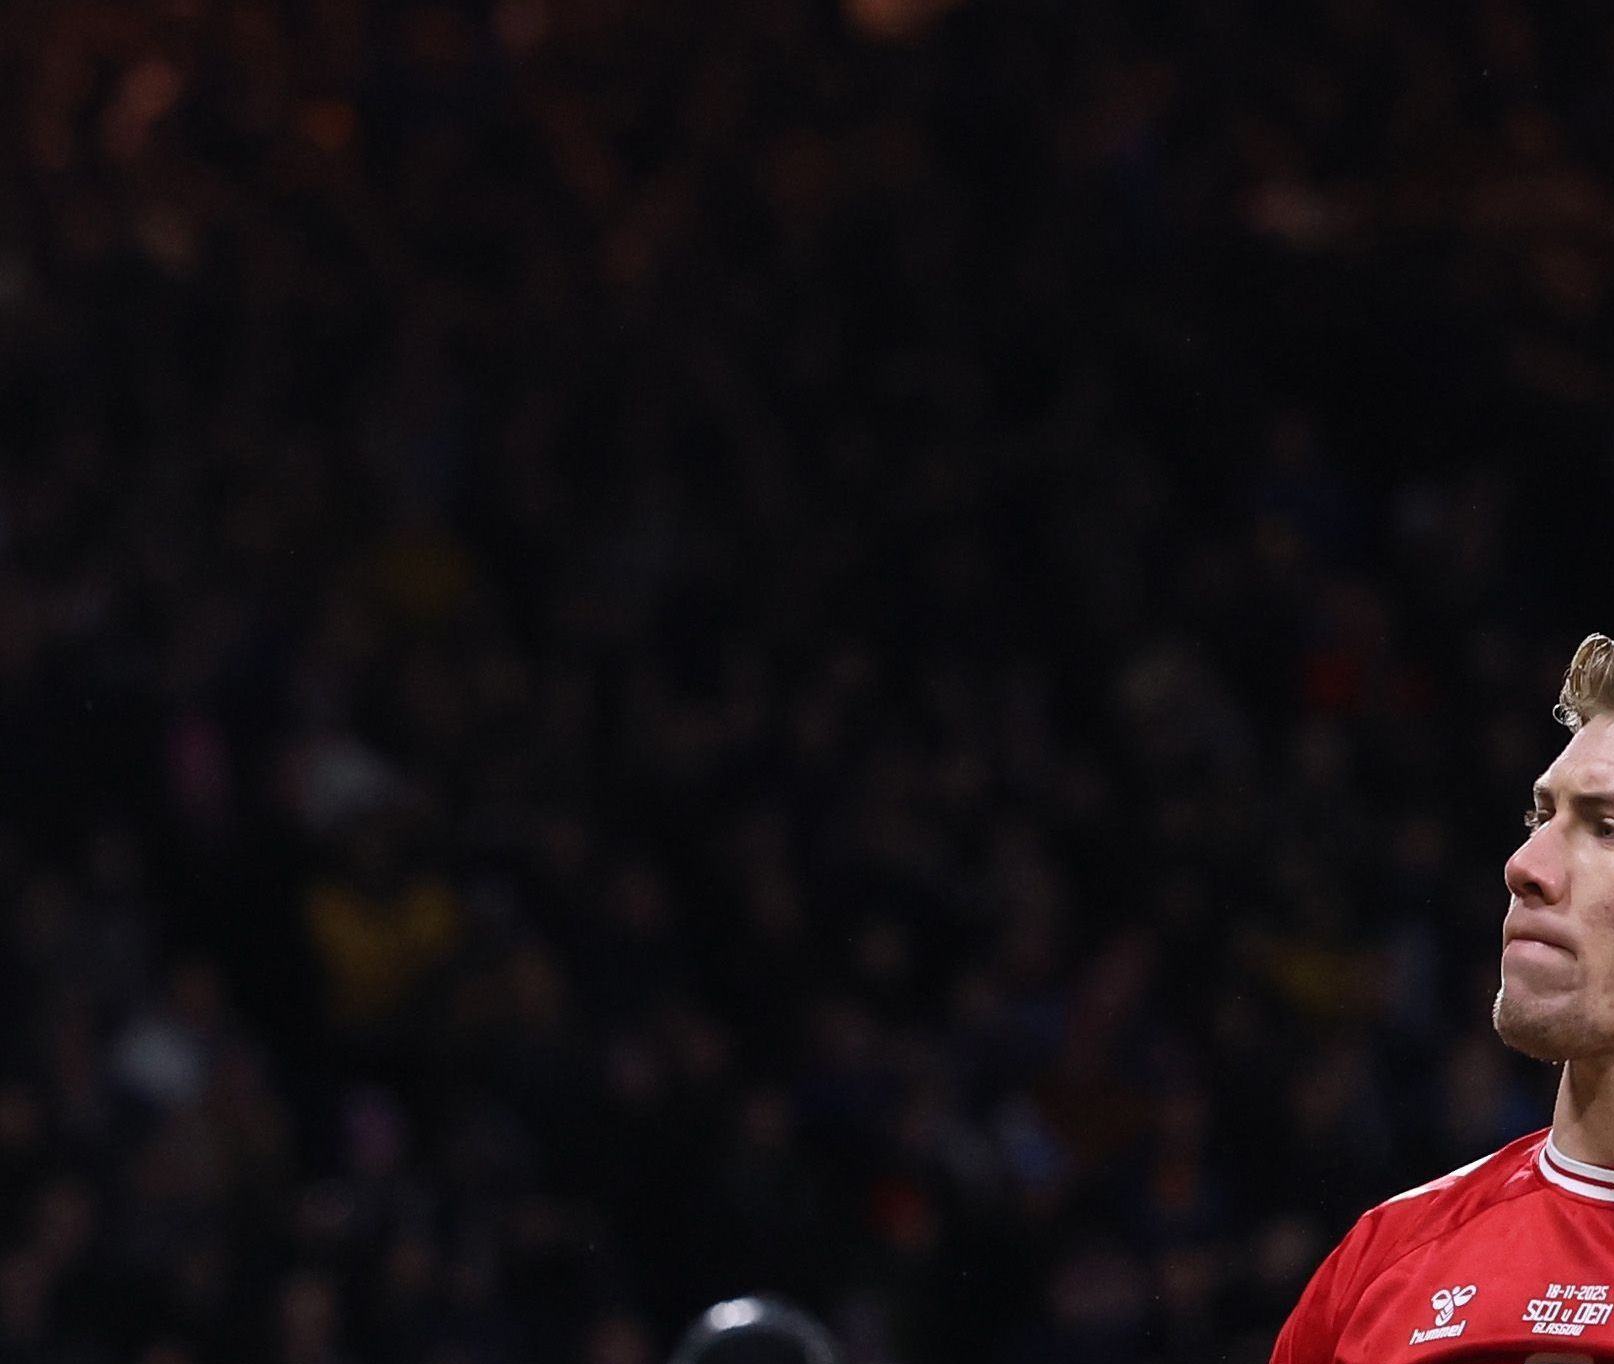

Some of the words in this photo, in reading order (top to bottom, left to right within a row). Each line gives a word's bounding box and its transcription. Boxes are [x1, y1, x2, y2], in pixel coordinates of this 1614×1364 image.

[1546, 1283, 1610, 1301] 18-11-2025
[1522, 1300, 1563, 1322] SCO
[1409, 1320, 1467, 1345] hummel
[1532, 1322, 1586, 1337] GLASGOW
